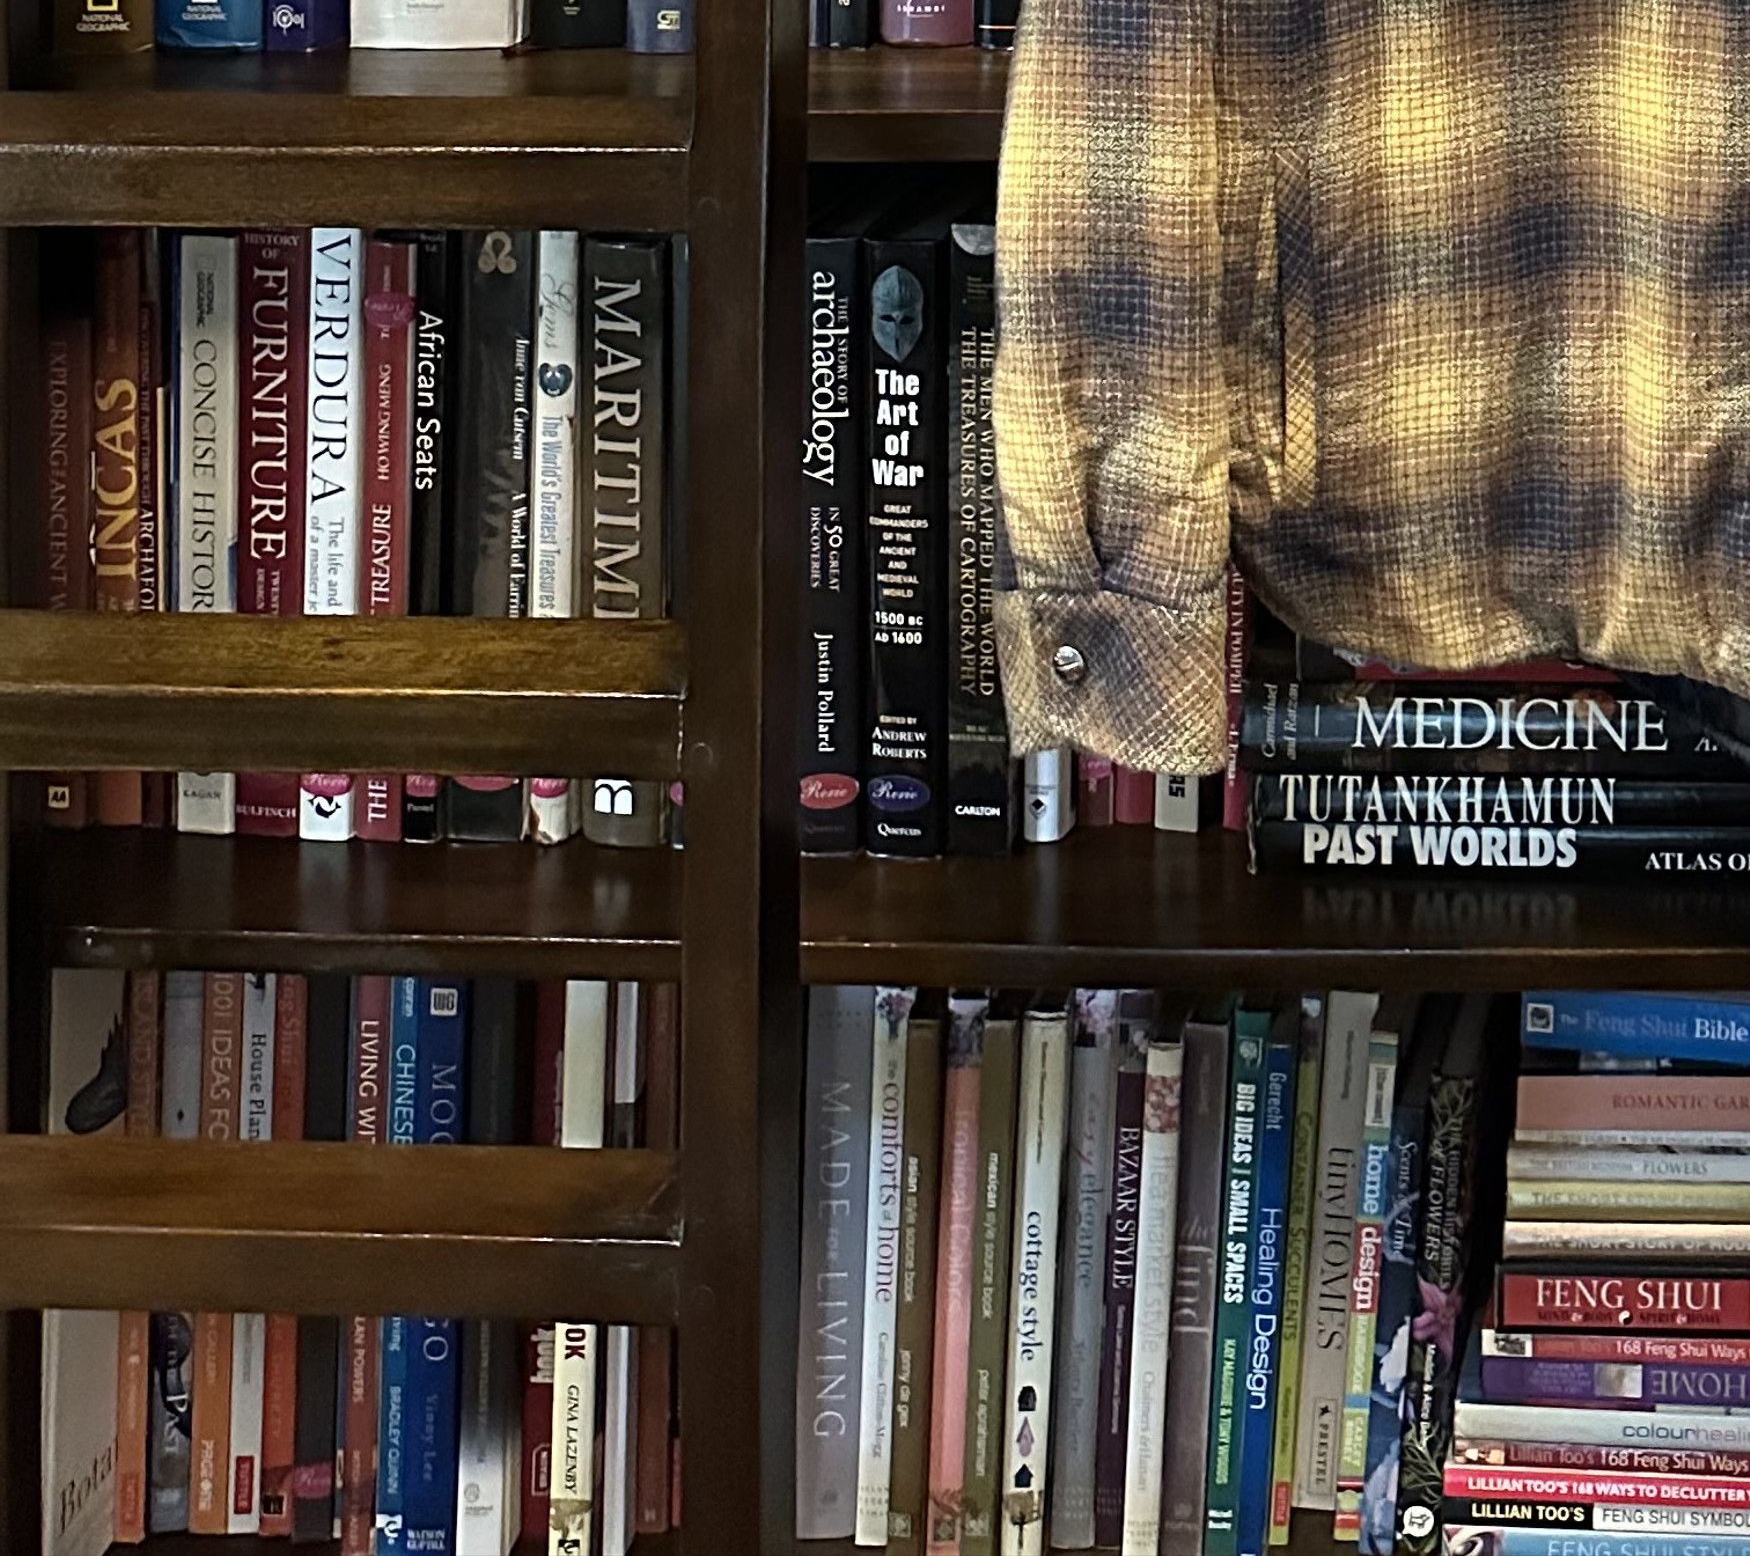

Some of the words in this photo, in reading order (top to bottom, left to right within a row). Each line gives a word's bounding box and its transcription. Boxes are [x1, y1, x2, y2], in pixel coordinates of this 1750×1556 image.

[310, 234, 353, 504] VERDURA
[416, 311, 443, 407] African
[803, 271, 849, 487] archaeology
[876, 369, 919, 396] The
[250, 268, 289, 559] FURNITURE
[877, 403, 918, 425] Art
[415, 417, 439, 490] Seats
[885, 434, 909, 457] of
[94, 379, 138, 580] INCAS
[872, 461, 923, 487] War
[1351, 697, 1669, 751] MEDICINE
[1280, 775, 1615, 824] TUTANKHAMUN
[1304, 825, 1400, 865] PAST
[1414, 827, 1577, 867] WORLDS
[1646, 853, 1721, 871] ATLAS
[1695, 1018, 1748, 1042] Bible
[1019, 1211, 1042, 1302] cottage
[1251, 1209, 1283, 1306] Healing
[1537, 1278, 1624, 1310] FENG
[1637, 1281, 1721, 1310] SHUI
[1018, 1309, 1043, 1362] style
[1248, 1313, 1278, 1410] Design
[1471, 1503, 1532, 1520] LILLIAN
